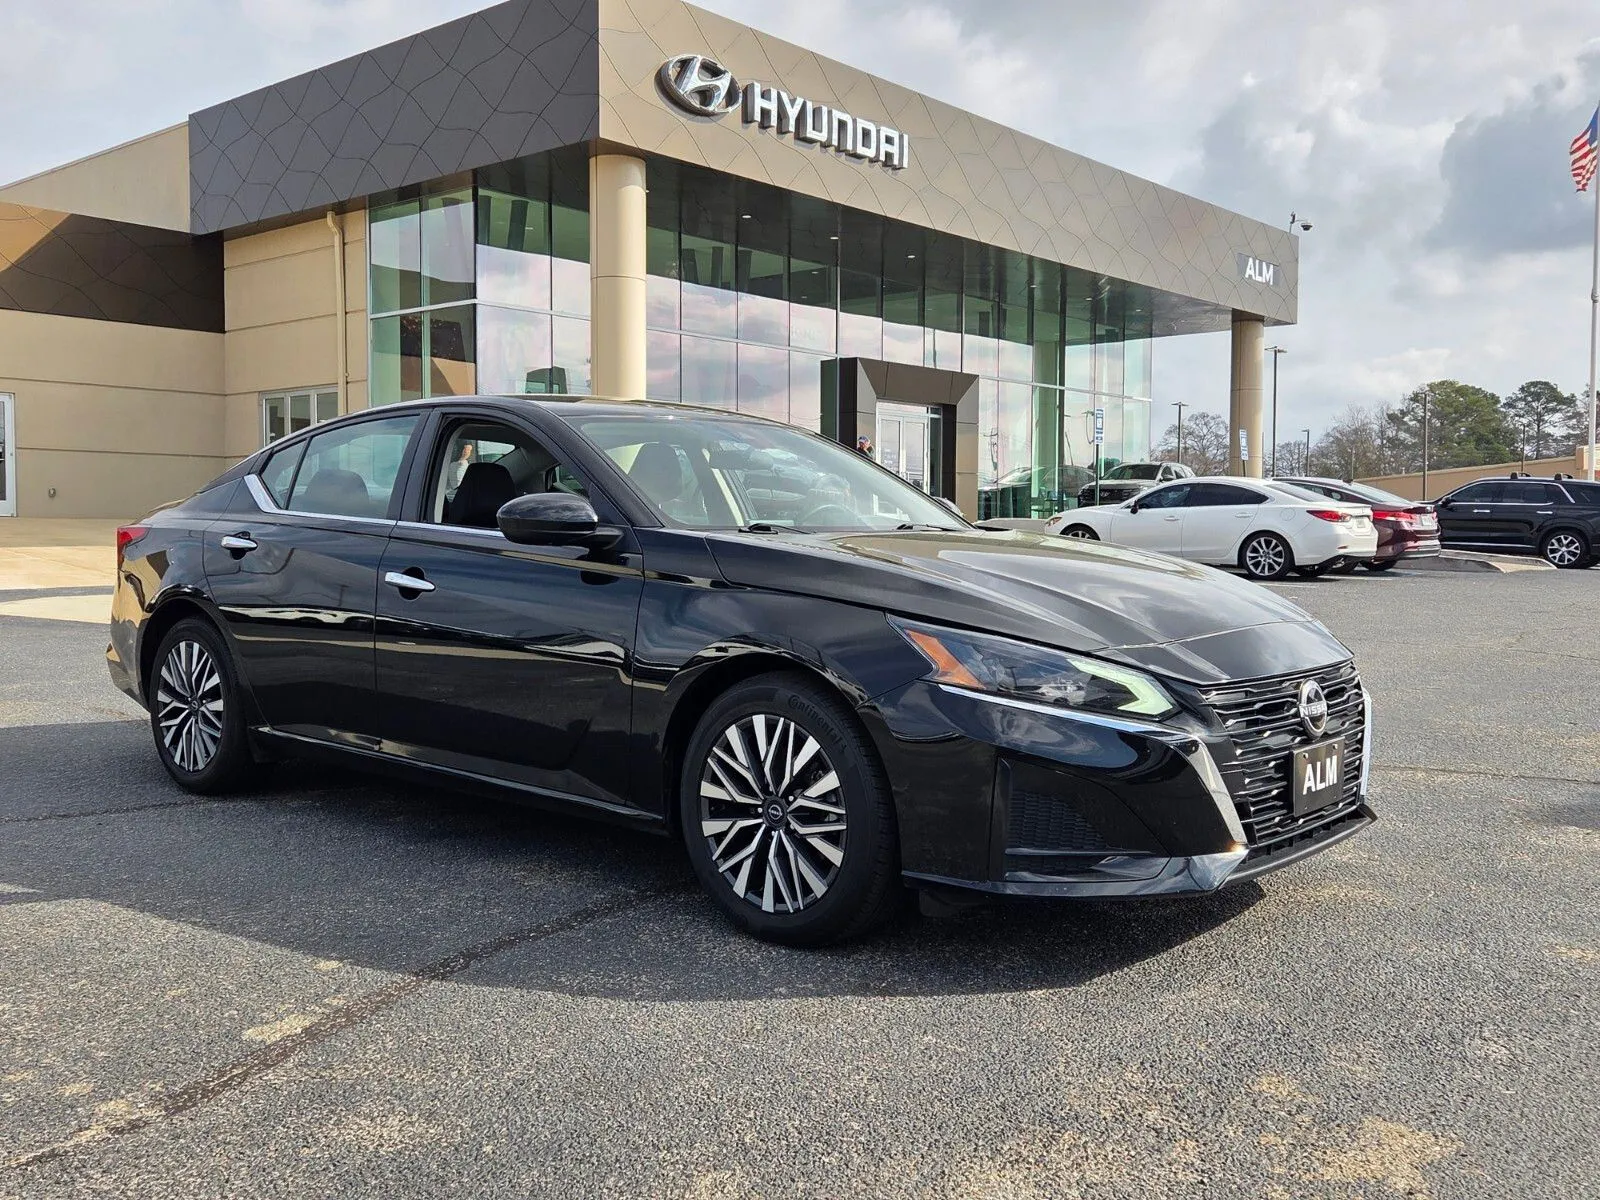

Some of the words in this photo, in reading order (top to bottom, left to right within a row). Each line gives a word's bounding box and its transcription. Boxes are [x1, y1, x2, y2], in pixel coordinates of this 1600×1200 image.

[744, 81, 909, 168] HYUNDAI
[1245, 257, 1274, 285] ALM
[1299, 702, 1327, 717] NISSA
[1303, 755, 1338, 795] ALM
